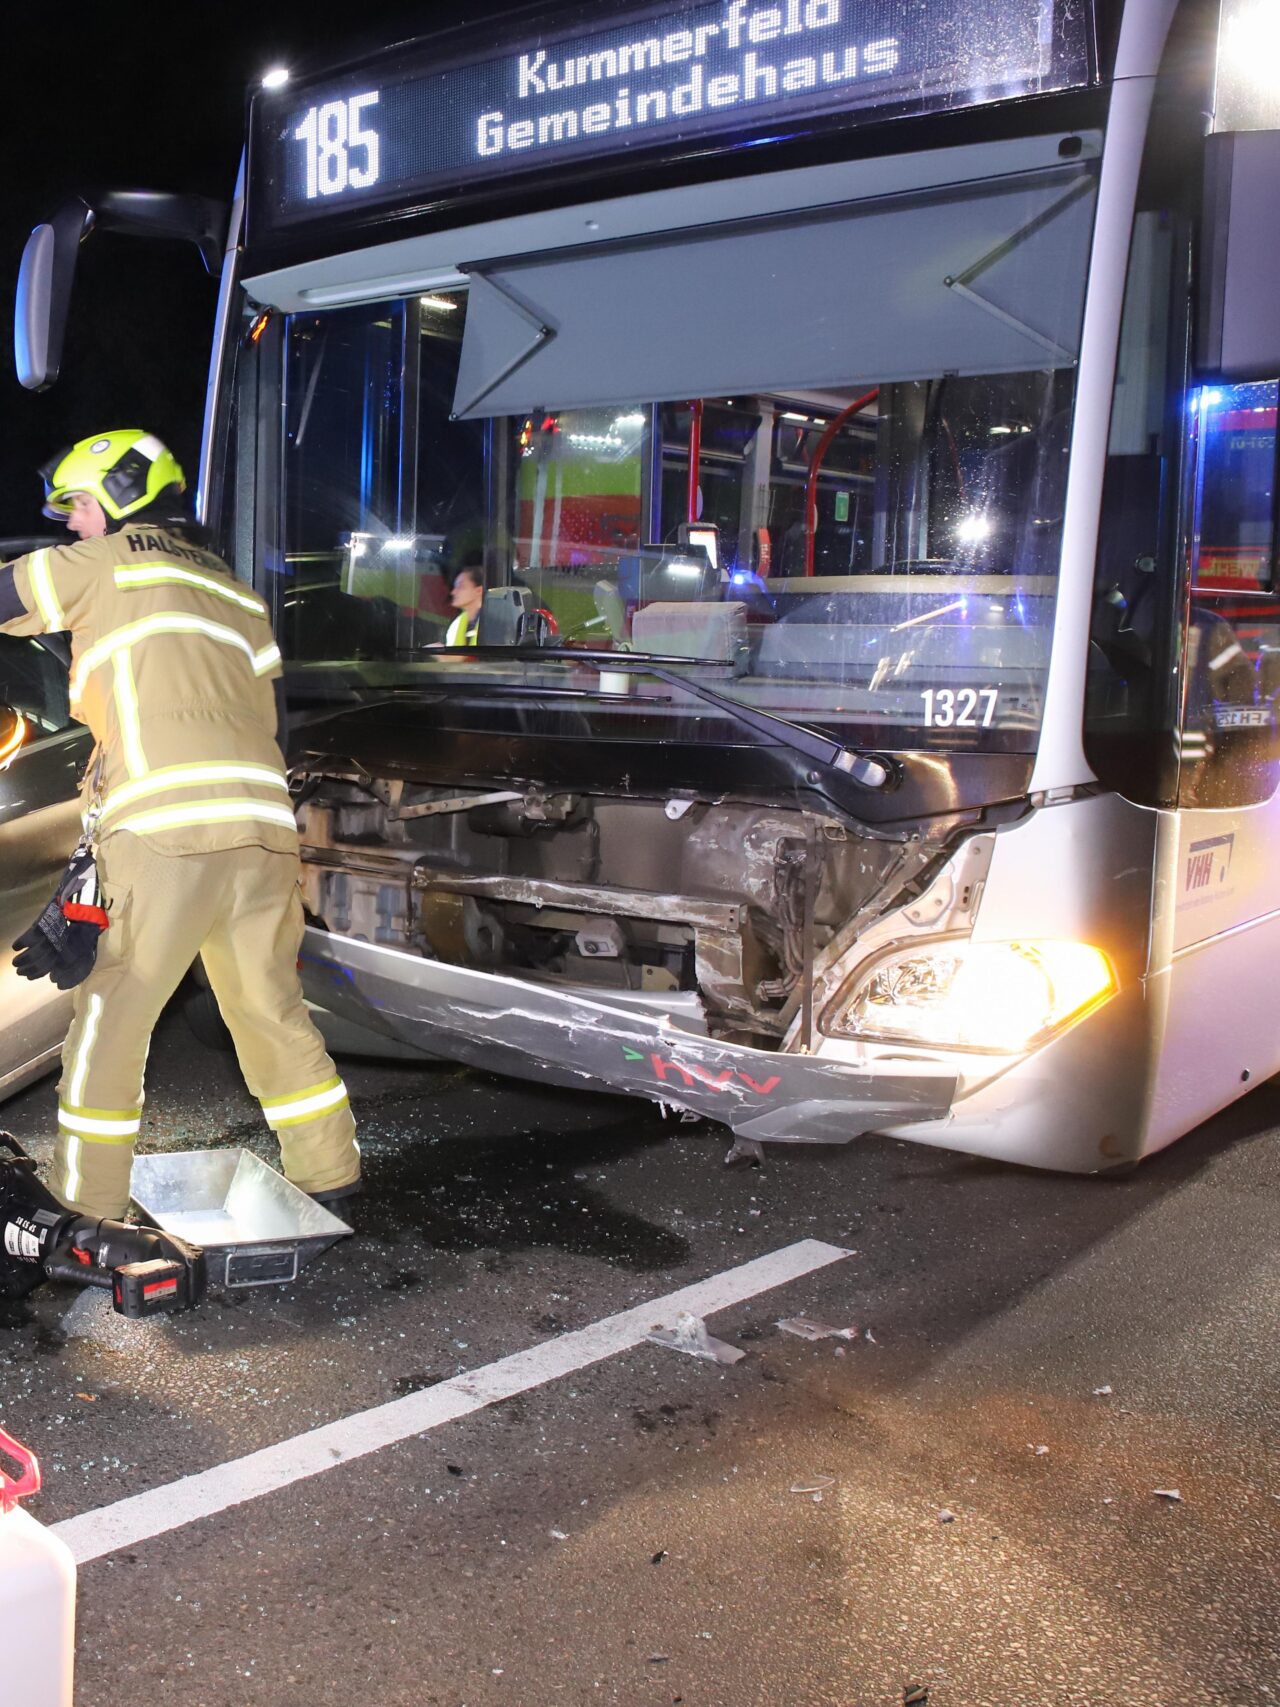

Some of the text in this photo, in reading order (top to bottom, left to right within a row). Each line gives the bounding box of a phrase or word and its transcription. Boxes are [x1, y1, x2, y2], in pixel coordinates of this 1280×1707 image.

[519, 0, 839, 98] Kummerfeld
[476, 38, 900, 157] Gemeindehaus
[295, 90, 380, 200] 185
[920, 687, 999, 727] 1327
[1185, 851, 1215, 892] VHH
[650, 1052, 782, 1094] hvv
